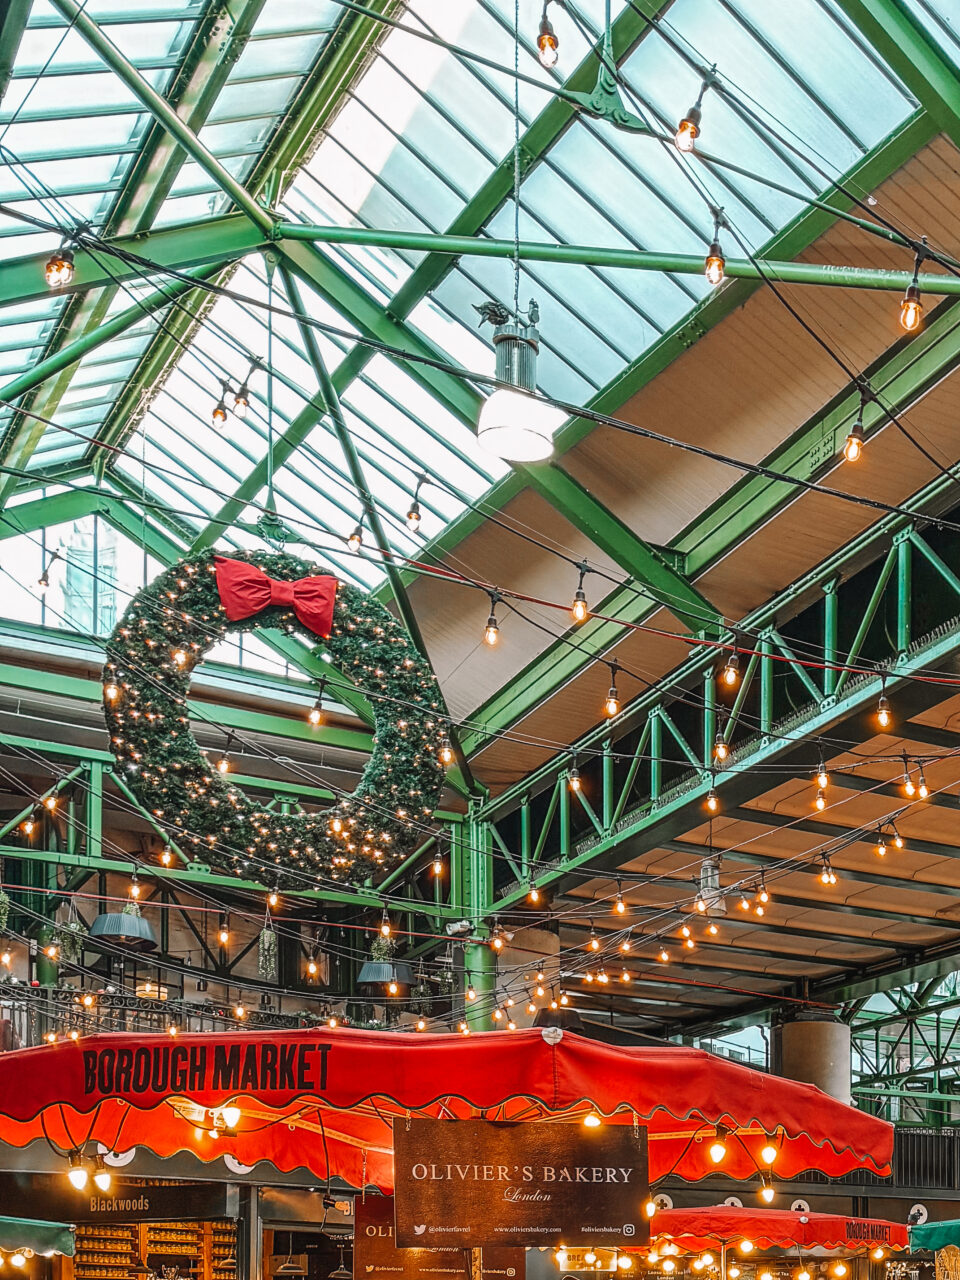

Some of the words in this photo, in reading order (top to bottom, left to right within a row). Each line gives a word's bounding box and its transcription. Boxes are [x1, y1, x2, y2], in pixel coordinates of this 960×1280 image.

[83, 1045, 206, 1095] BOROUGH
[212, 1043, 332, 1091] MARKET
[412, 1163, 533, 1181] OLIVIER'S
[543, 1166, 633, 1183] BAKERY
[502, 1186, 551, 1202] London
[90, 1195, 149, 1212] Blackwoods
[494, 1226, 562, 1234] www.oliviersbakery.com
